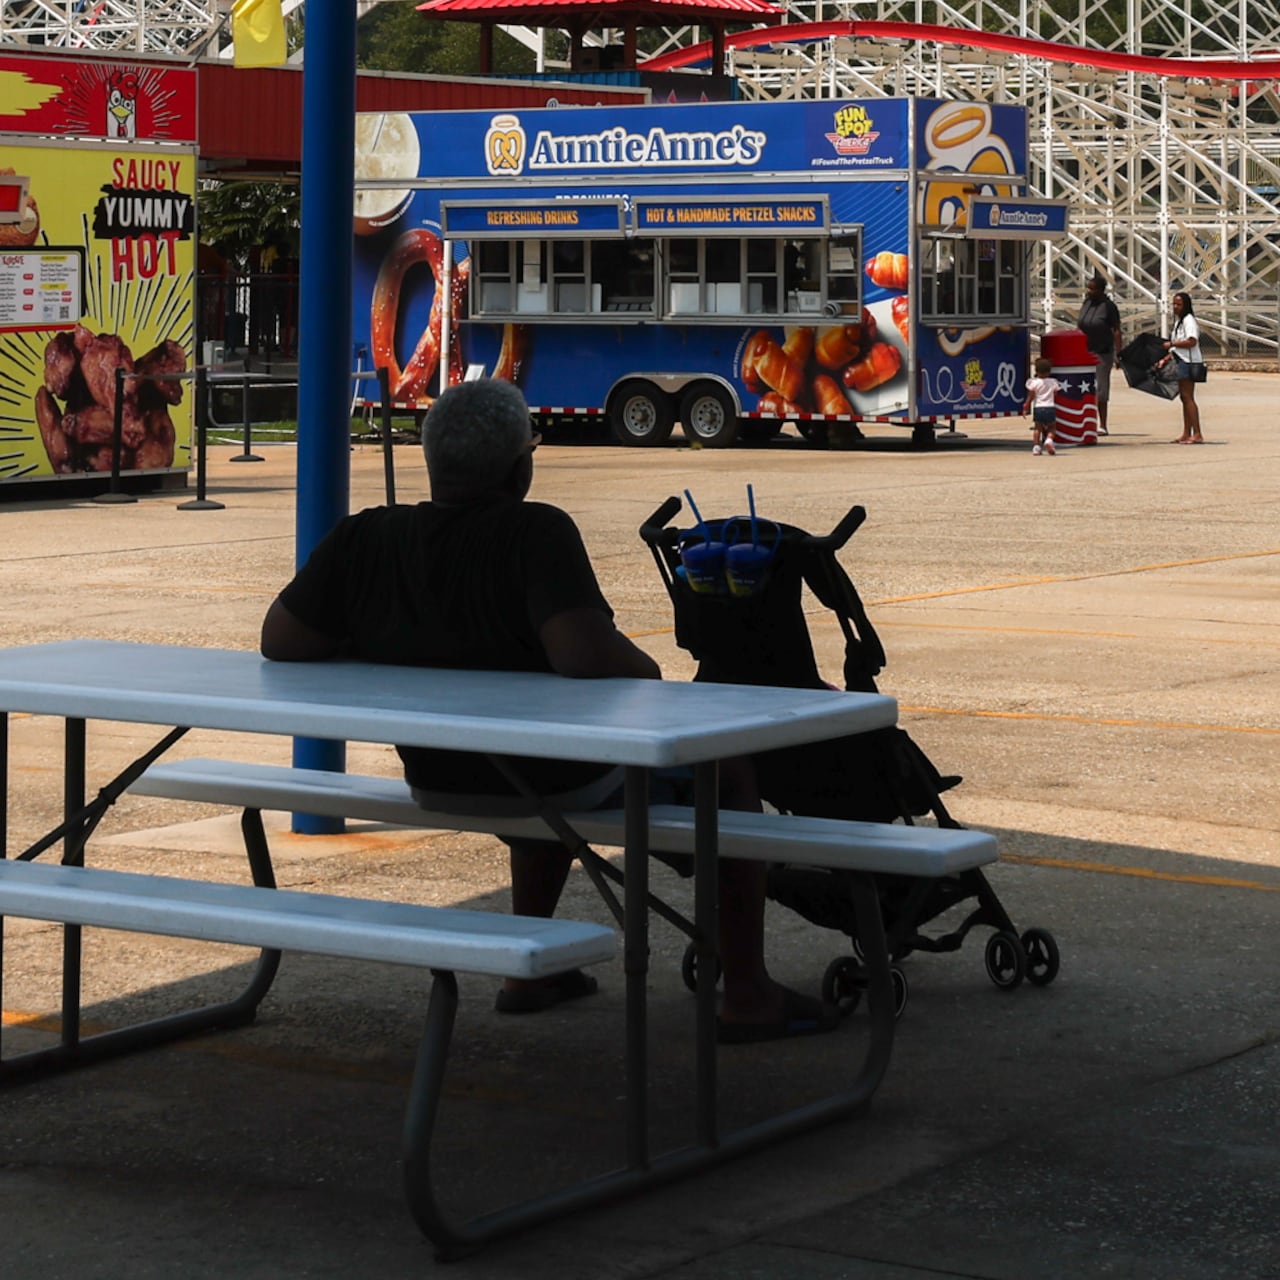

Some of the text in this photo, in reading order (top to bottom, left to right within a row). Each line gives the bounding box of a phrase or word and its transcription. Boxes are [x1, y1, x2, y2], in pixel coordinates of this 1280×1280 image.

[834, 106, 866, 125] FUN
[836, 120, 874, 137] SPOT
[112, 158, 181, 192] SAUCY
[104, 197, 188, 229] YUMMY
[487, 209, 579, 225] REFRESHING DRINKS
[646, 206, 817, 223] HOT & HANDMADE PRETZEL SNACKS
[111, 230, 182, 283] HOT
